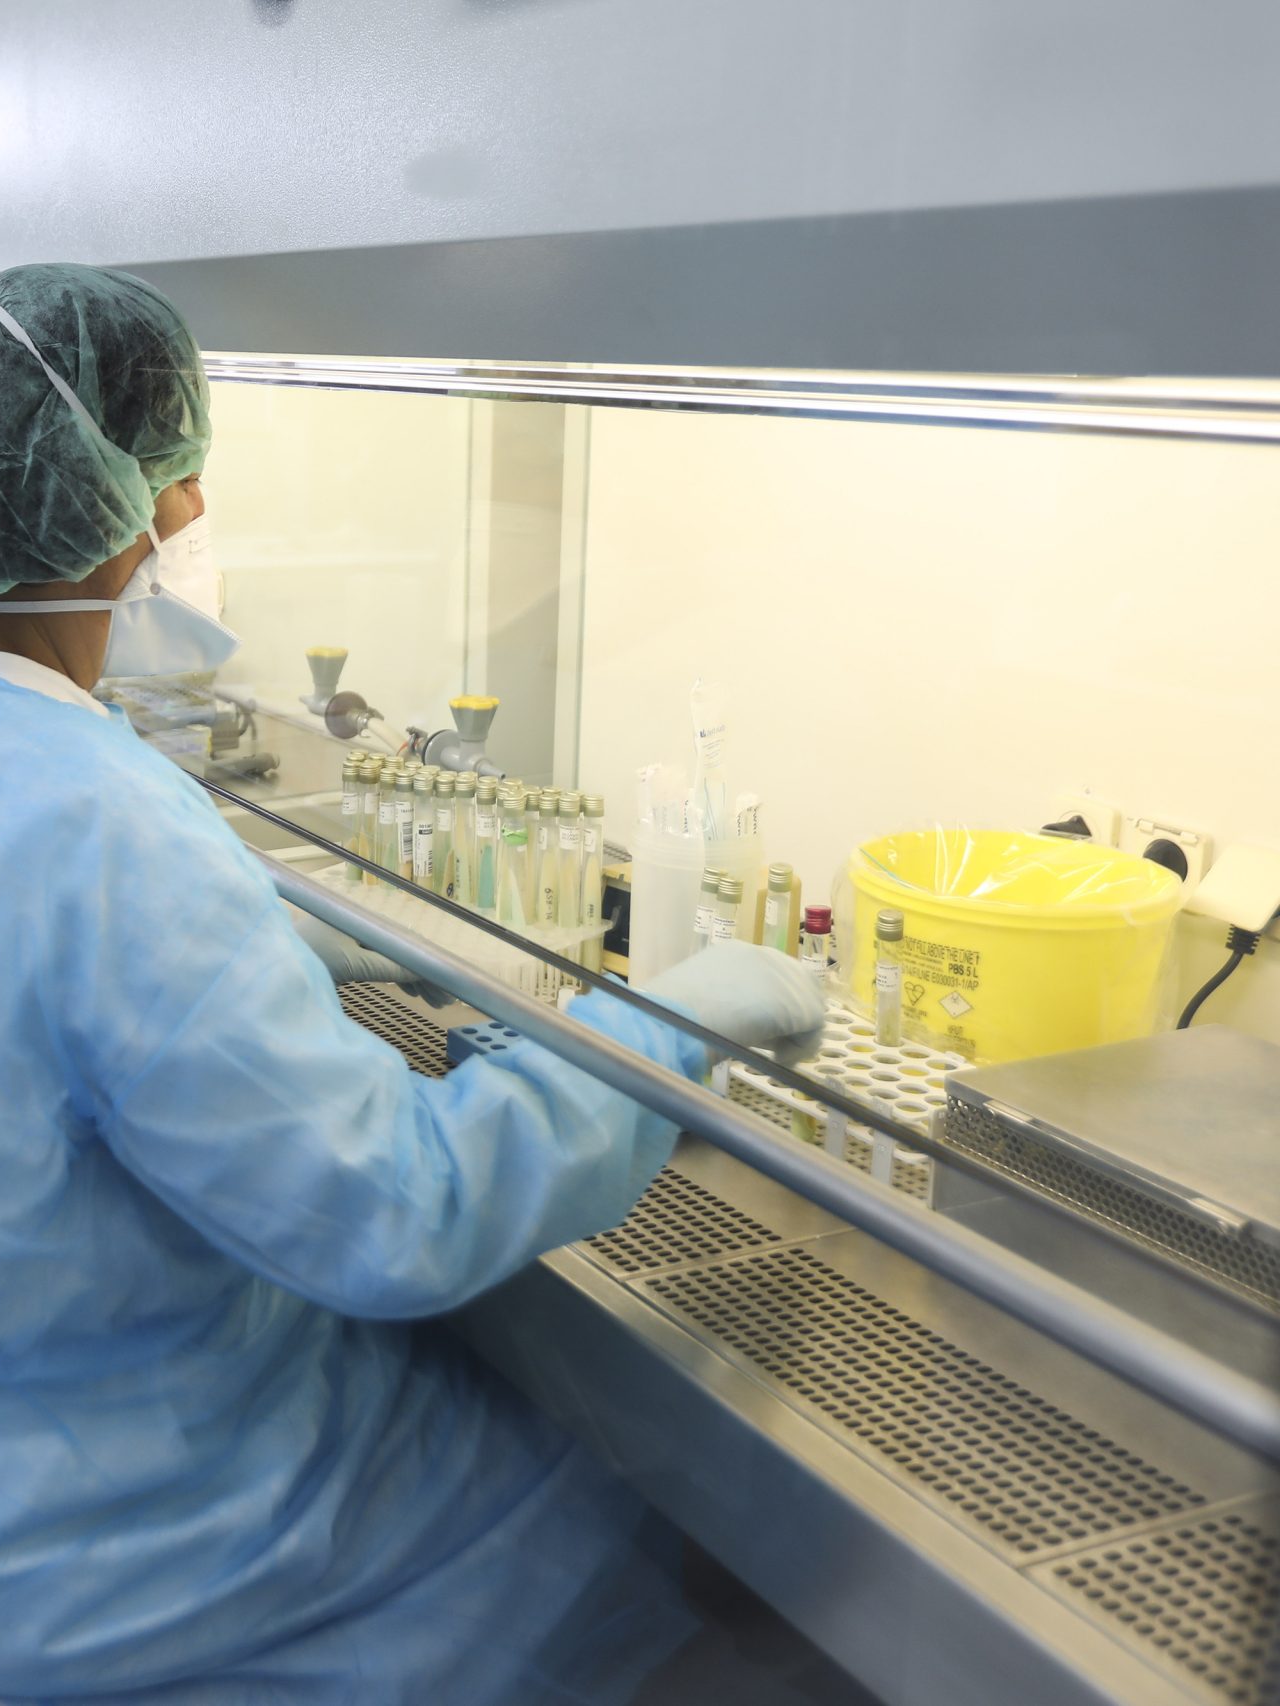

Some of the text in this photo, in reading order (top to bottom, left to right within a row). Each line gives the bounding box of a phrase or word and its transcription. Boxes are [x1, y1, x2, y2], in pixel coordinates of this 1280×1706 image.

[948, 963, 979, 978] PBS 5 L
